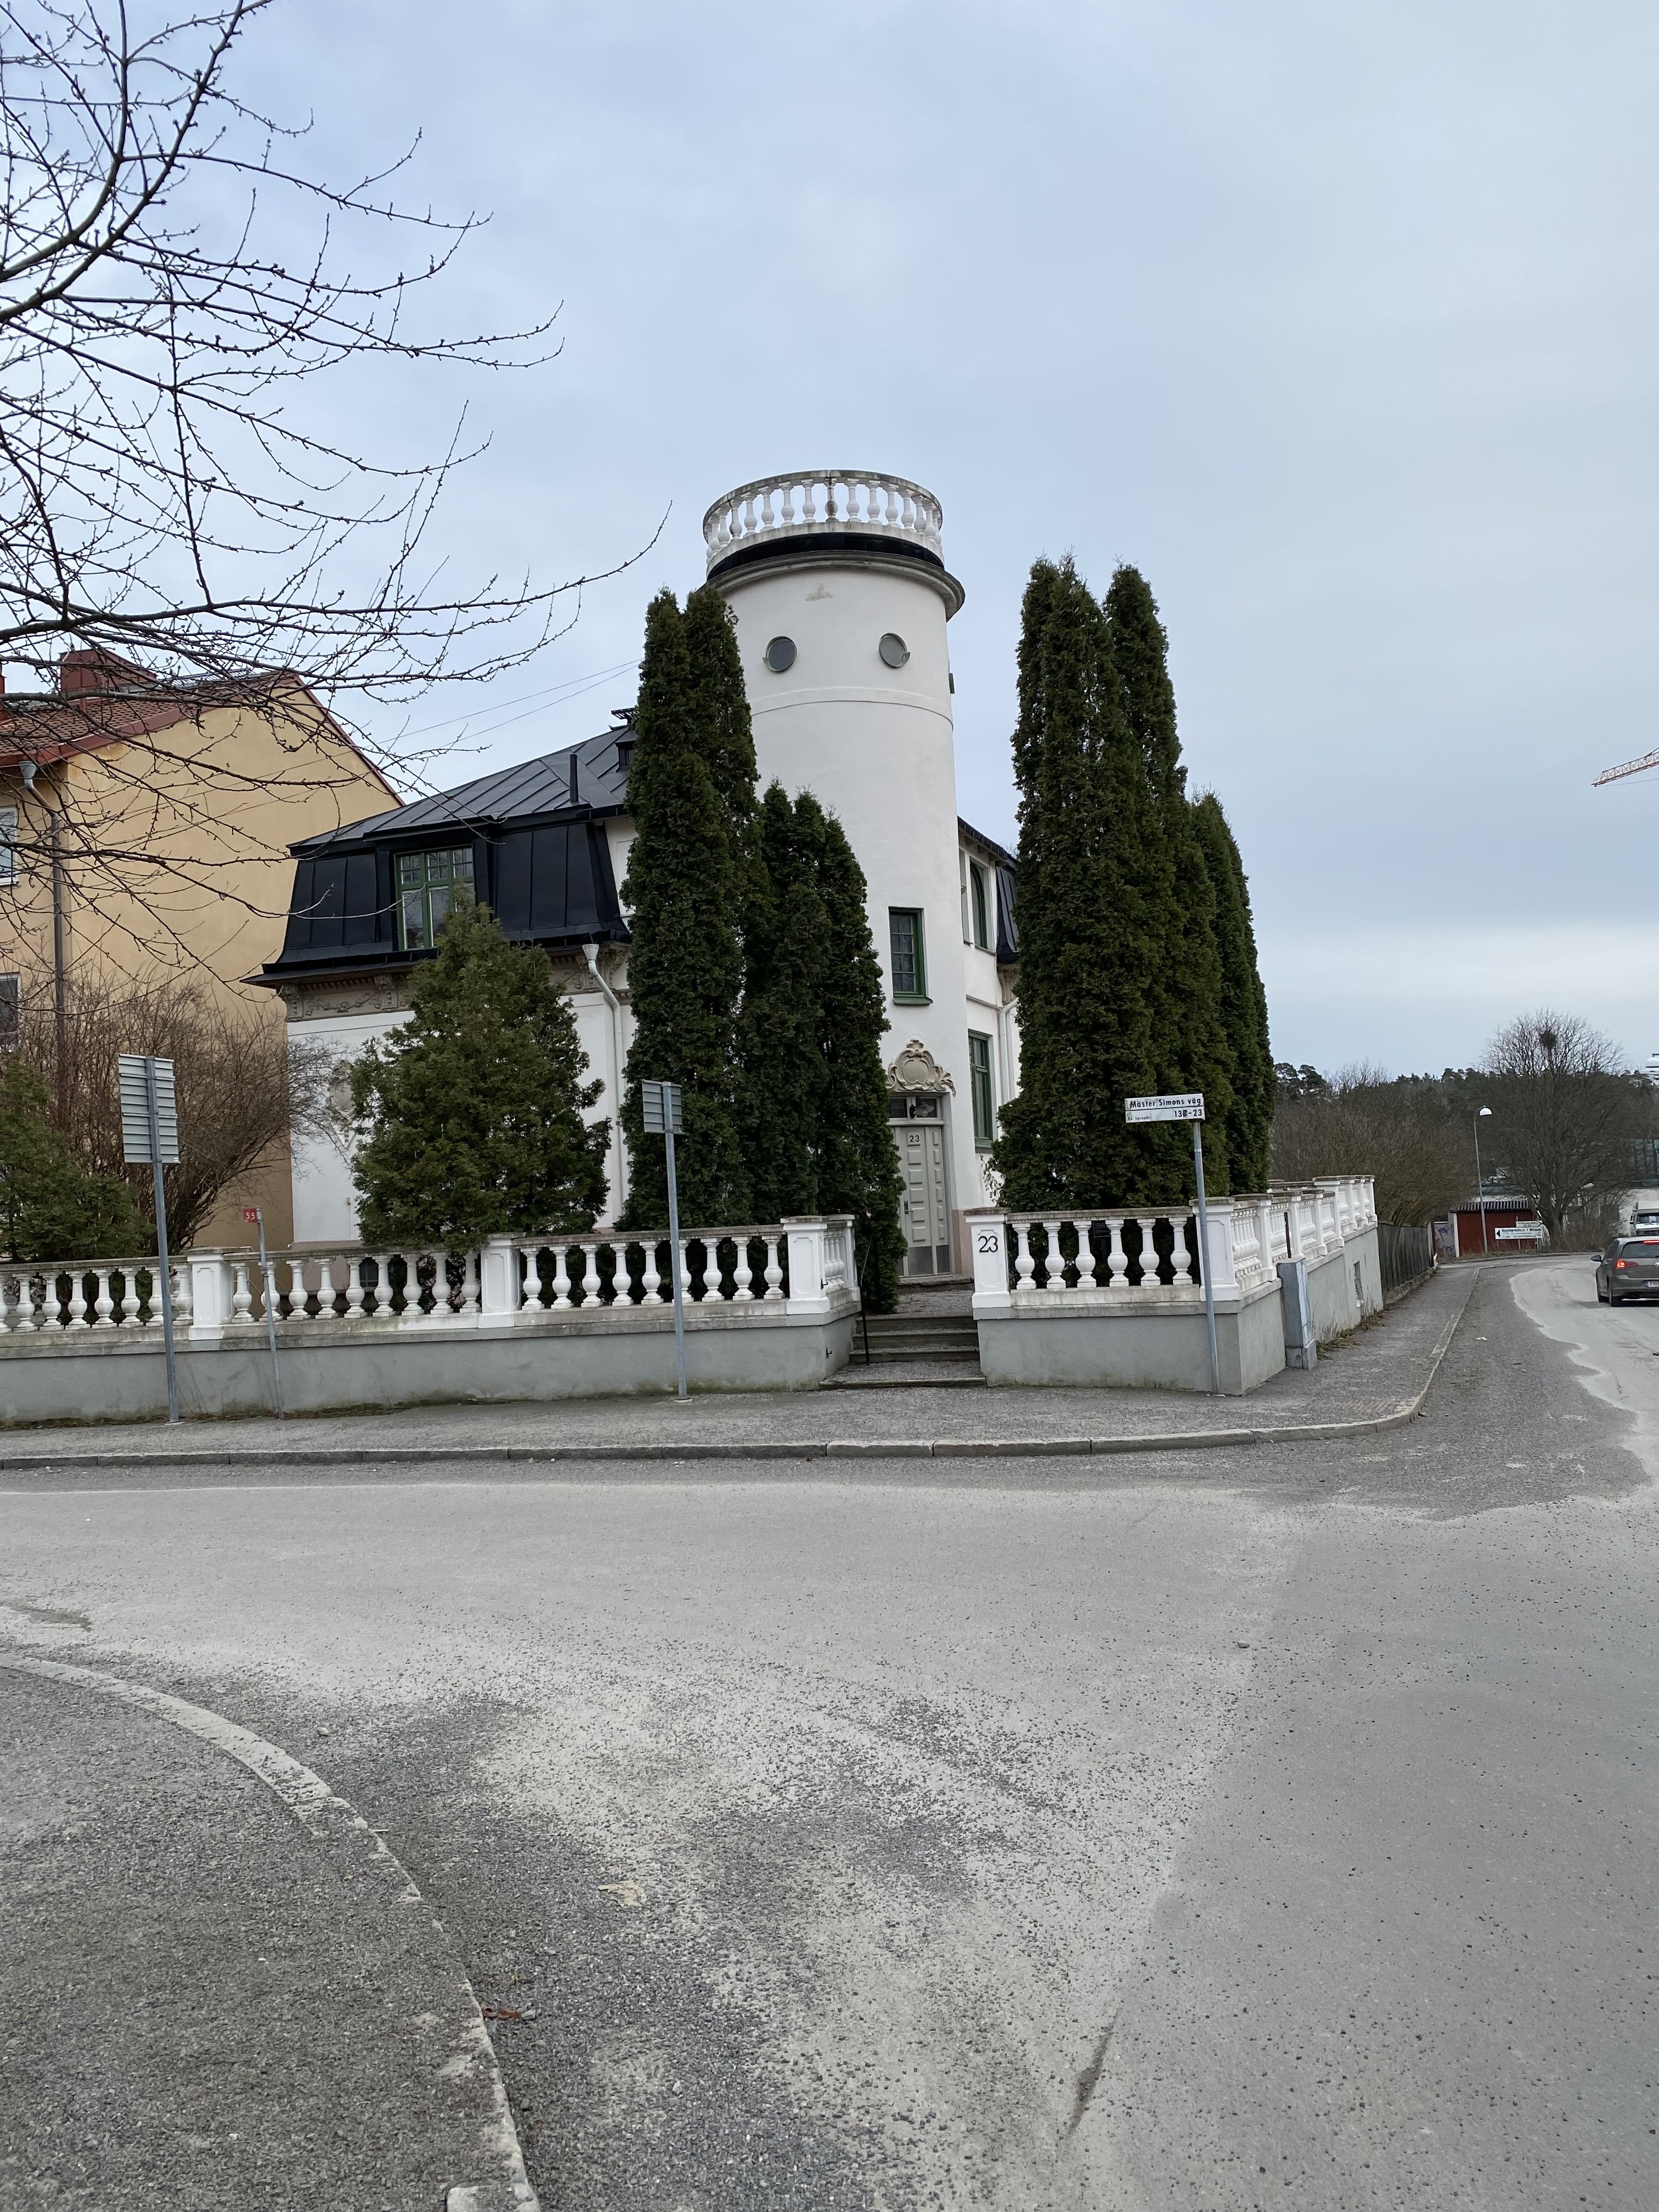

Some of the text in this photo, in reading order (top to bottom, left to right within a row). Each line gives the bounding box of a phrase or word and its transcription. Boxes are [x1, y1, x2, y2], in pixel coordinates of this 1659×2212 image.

[1130, 1100, 1156, 1109] Mäster
[1187, 1097, 1201, 1105] väg
[978, 1235, 998, 1253] 23
